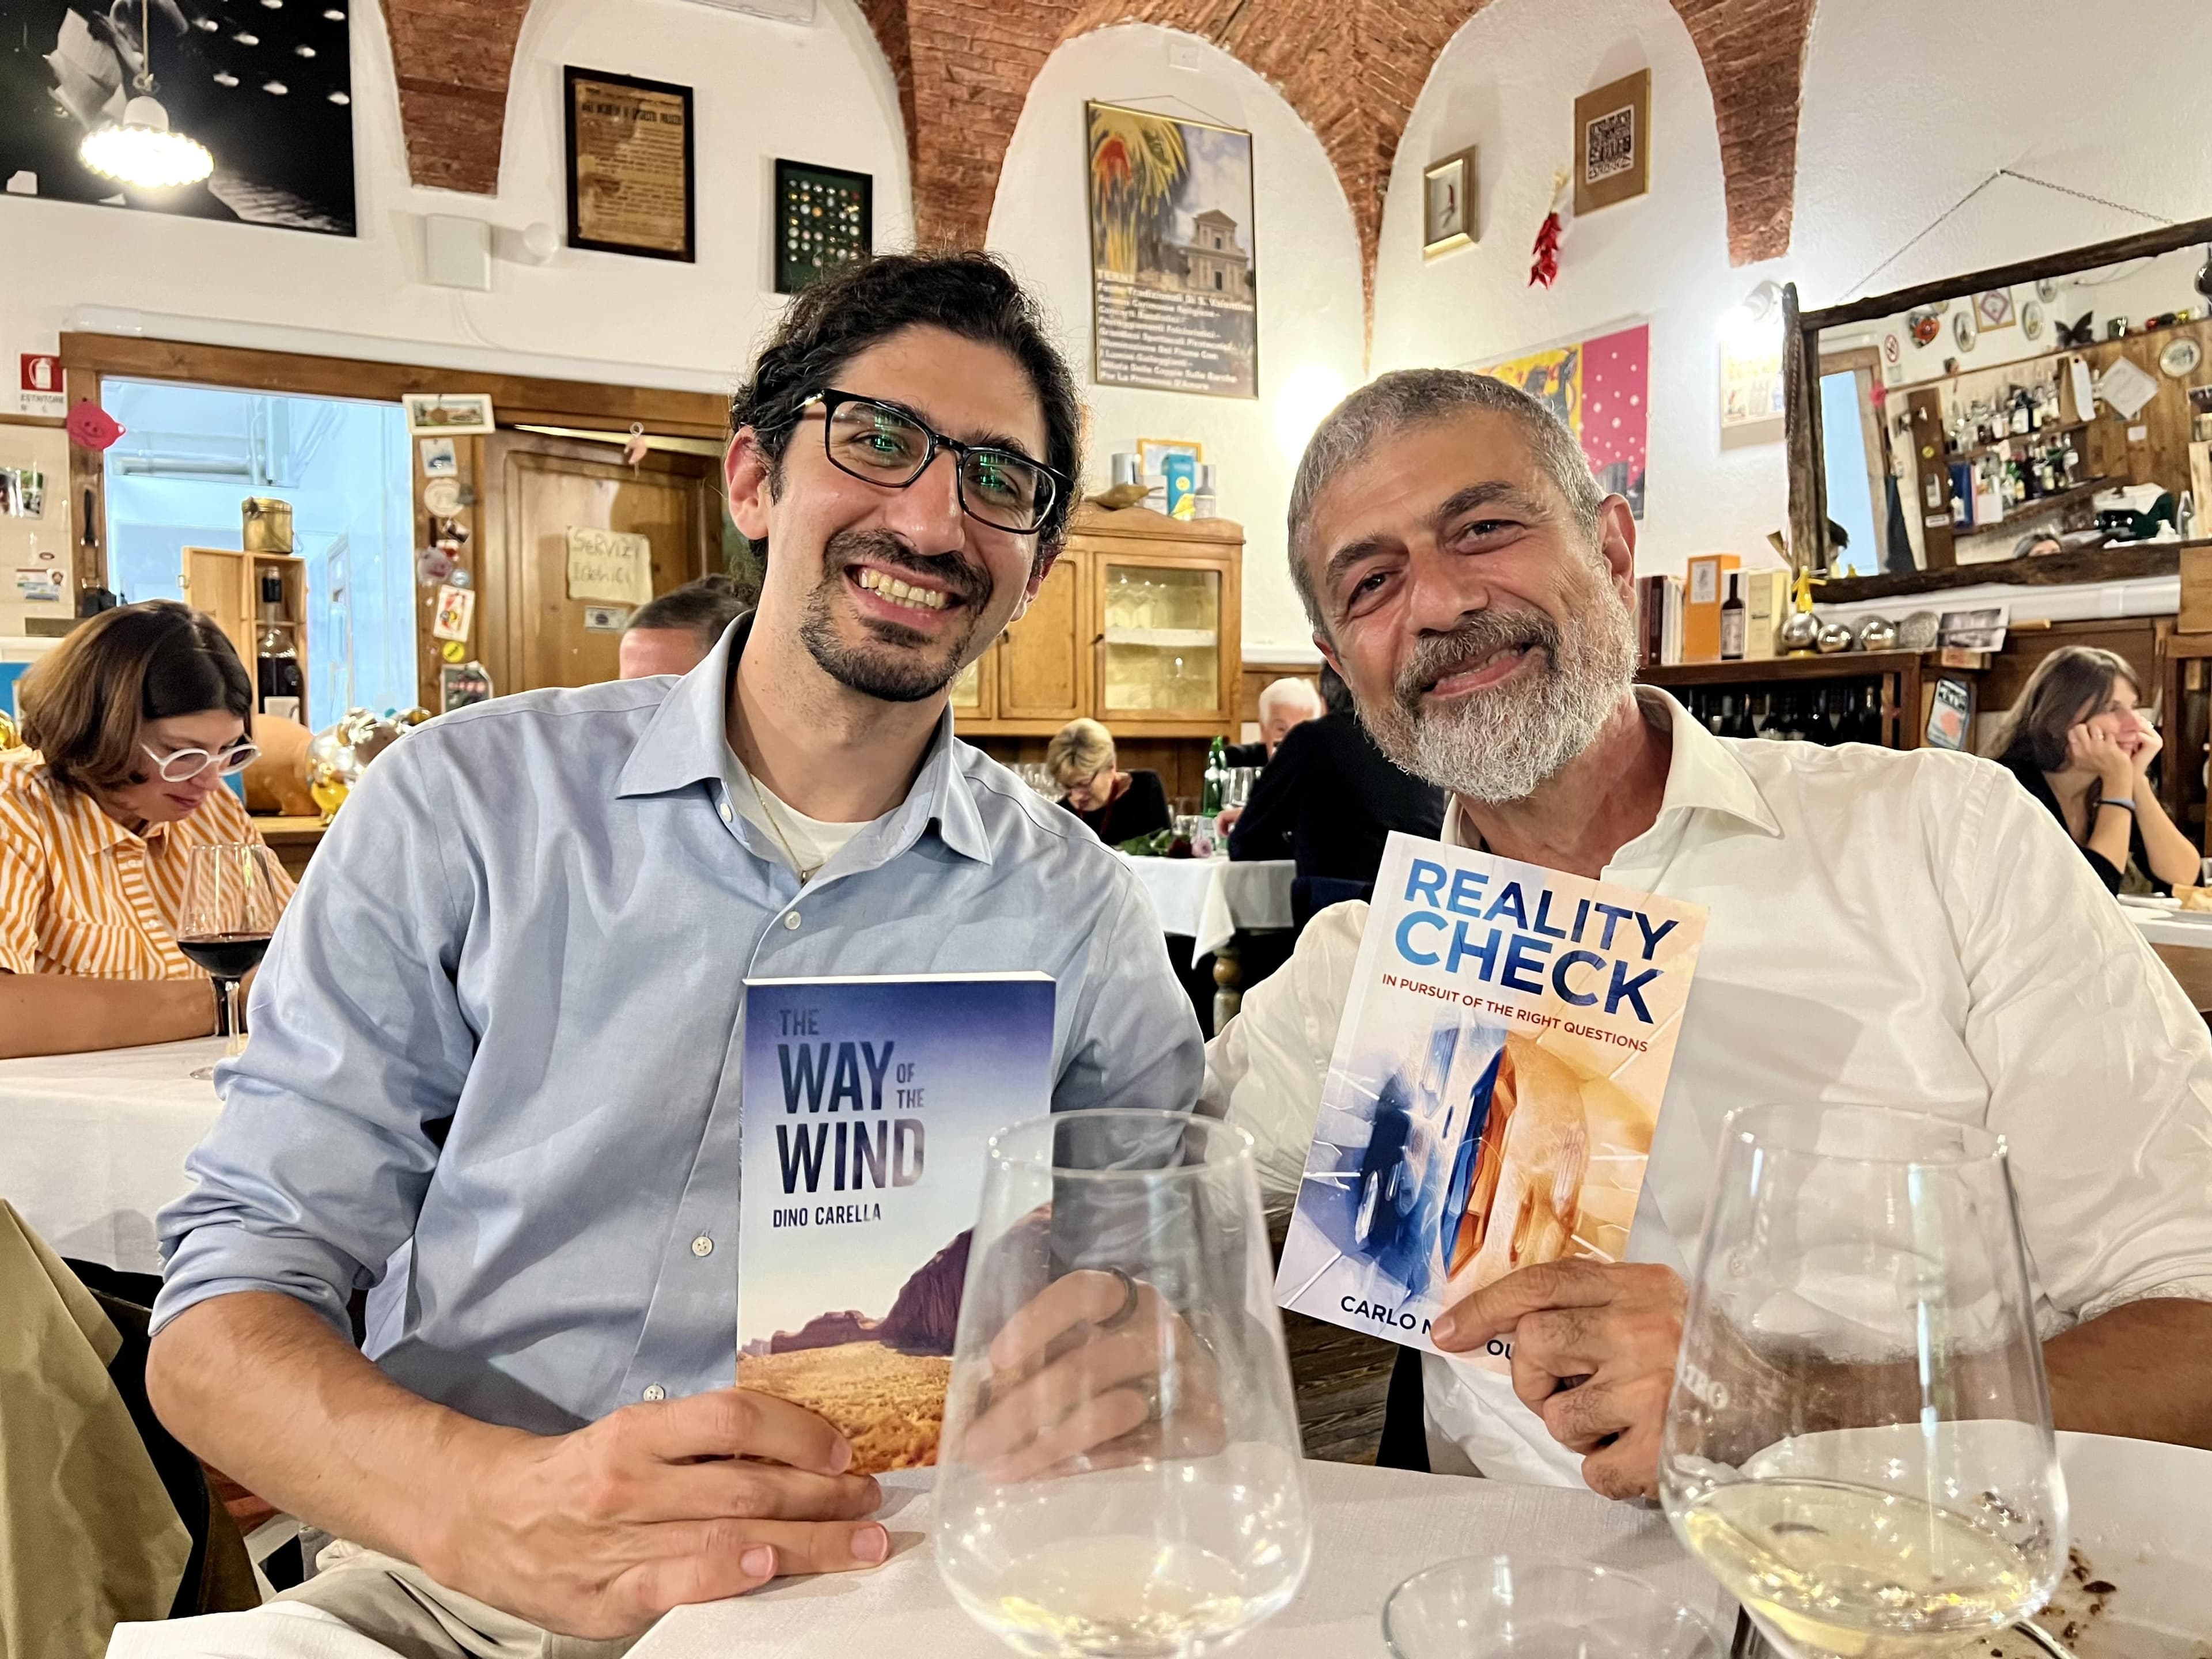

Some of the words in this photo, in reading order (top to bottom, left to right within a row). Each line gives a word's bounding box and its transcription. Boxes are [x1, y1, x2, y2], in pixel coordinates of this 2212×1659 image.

[1404, 858, 1679, 960] REALITY
[1395, 910, 1664, 1024] CHECK
[779, 1009, 819, 1036] THE
[1382, 974, 1397, 986] IN
[1400, 978, 1460, 1002] PURSUIT
[1463, 994, 1482, 1008] OF
[1487, 1001, 1513, 1017] THE
[1517, 1009, 1562, 1029] RIGHT
[1564, 1022, 1649, 1052] QUESTIONS
[778, 1041, 895, 1113] WAY
[896, 1063, 916, 1083] OF
[896, 1088, 925, 1109] THE
[776, 1118, 925, 1194] WIND
[773, 1207, 808, 1228] DINO
[815, 1203, 881, 1224] CARELLA
[1341, 1296, 1416, 1330] CARLO
